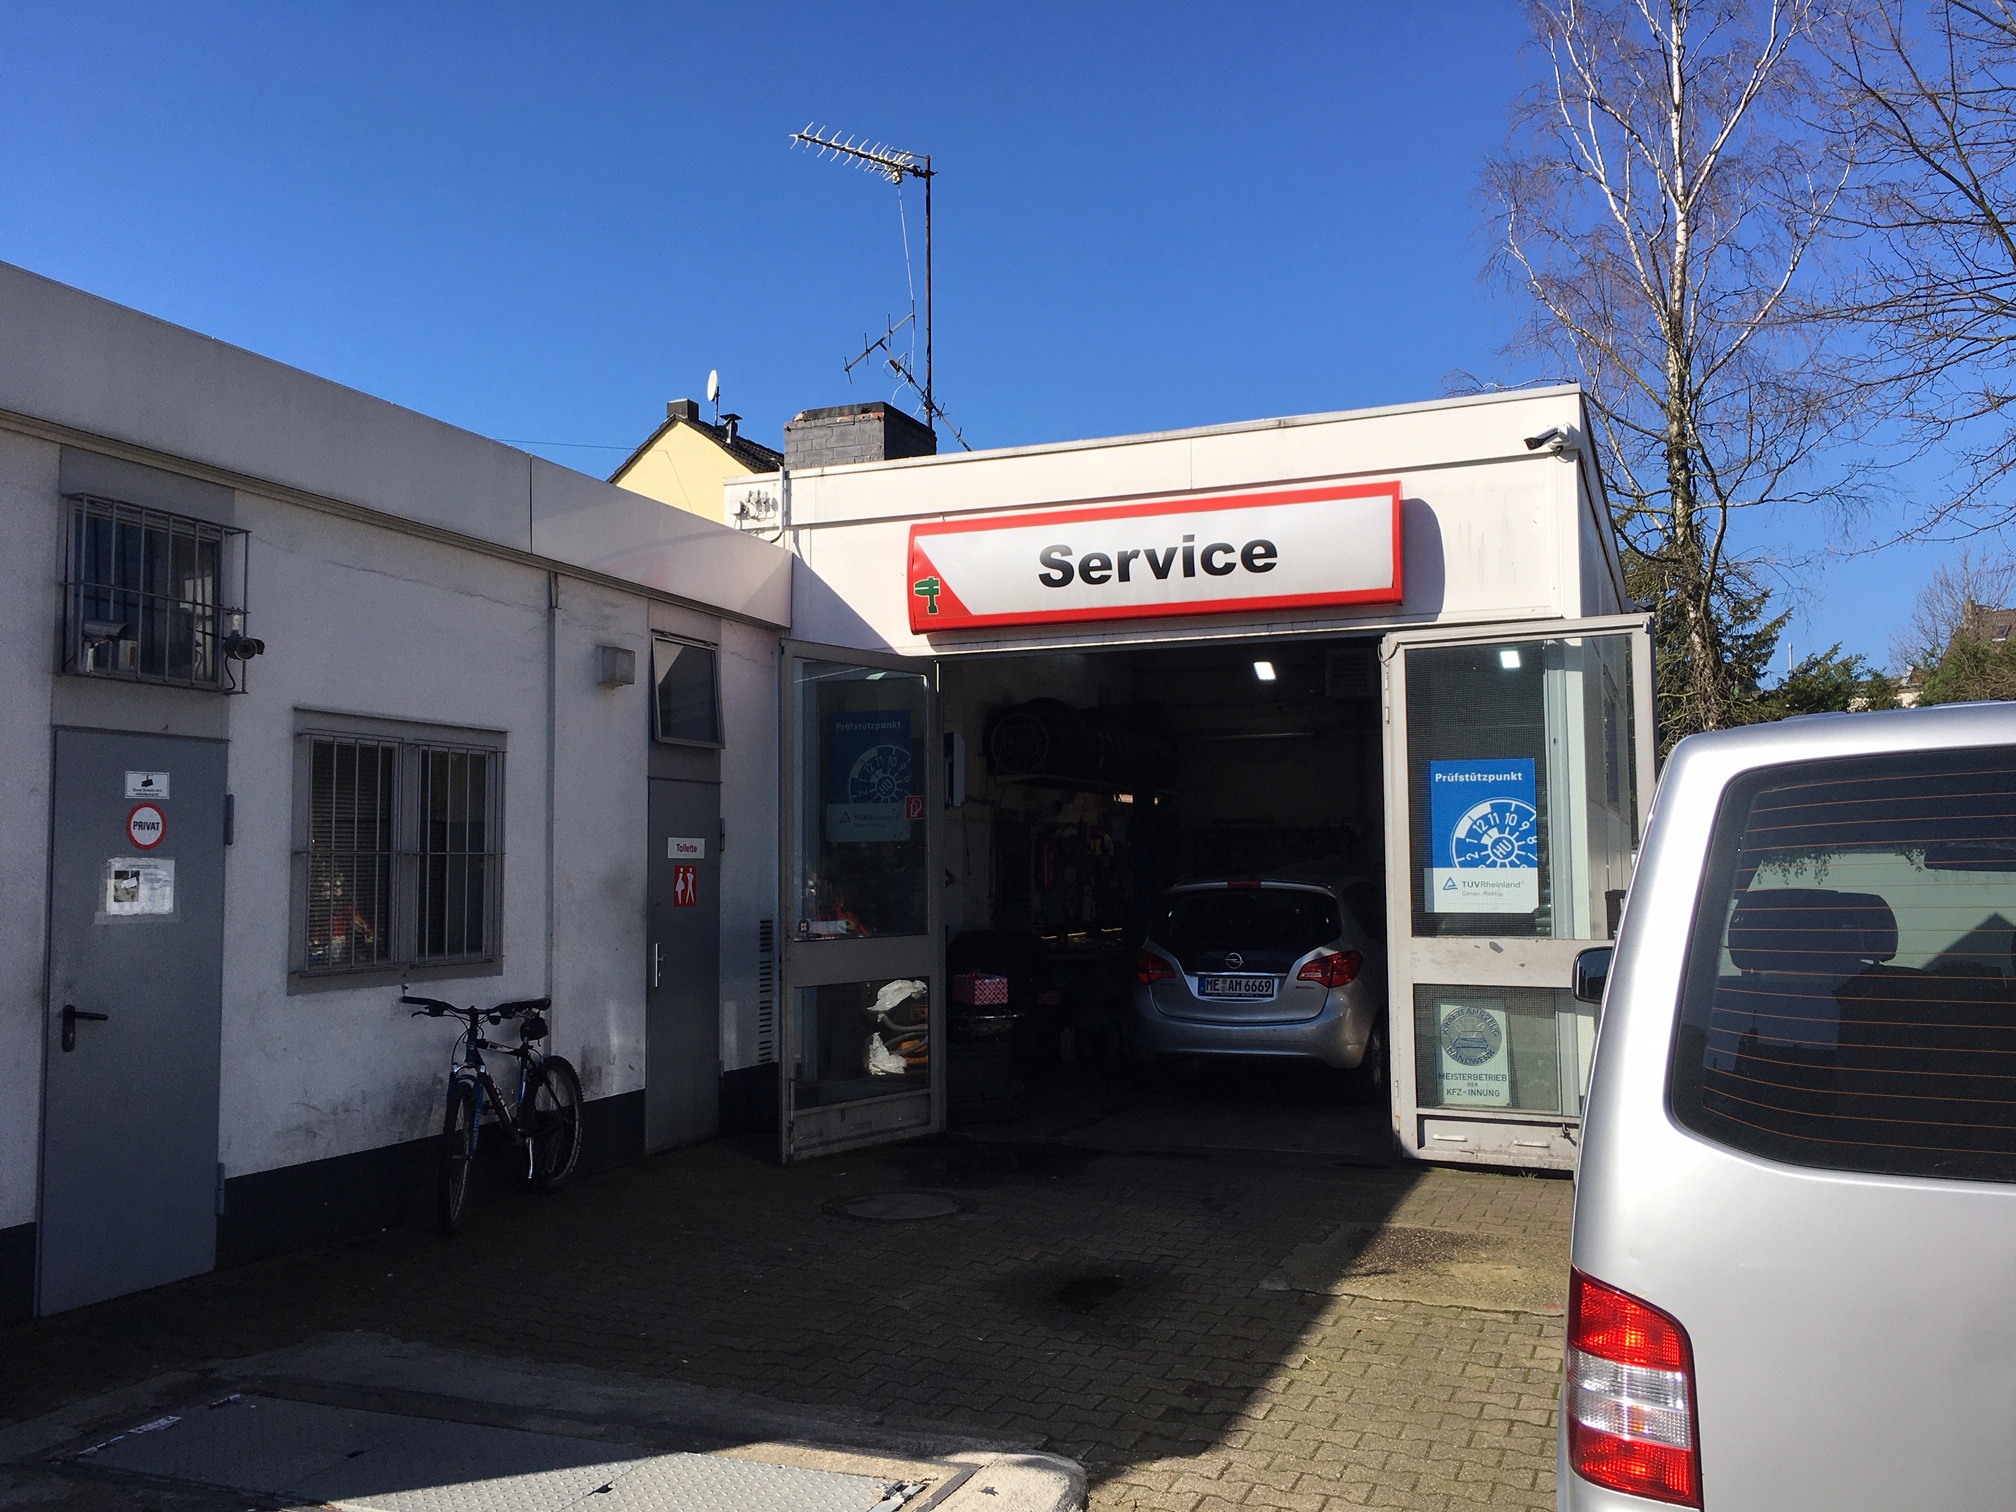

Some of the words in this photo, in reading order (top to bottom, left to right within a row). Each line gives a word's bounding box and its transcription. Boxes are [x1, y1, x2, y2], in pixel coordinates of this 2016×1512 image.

[1038, 534, 1278, 588] Service
[836, 721, 901, 731] Prüfstützpunkt
[1435, 772, 1523, 783] Prüfstützpunkt
[1488, 813, 1500, 825] 11
[1505, 812, 1518, 826] 10
[132, 821, 160, 831] PRIVAT
[1473, 819, 1488, 834] 12
[676, 843, 698, 853] Toilette
[1493, 839, 1513, 858] HU
[1206, 979, 1220, 991] ME
[1228, 979, 1242, 992] AM
[1244, 980, 1271, 993] 6669
[1446, 1045, 1495, 1065] HANDWERK
[1438, 1073, 1507, 1082] MEISTERBETRIEB
